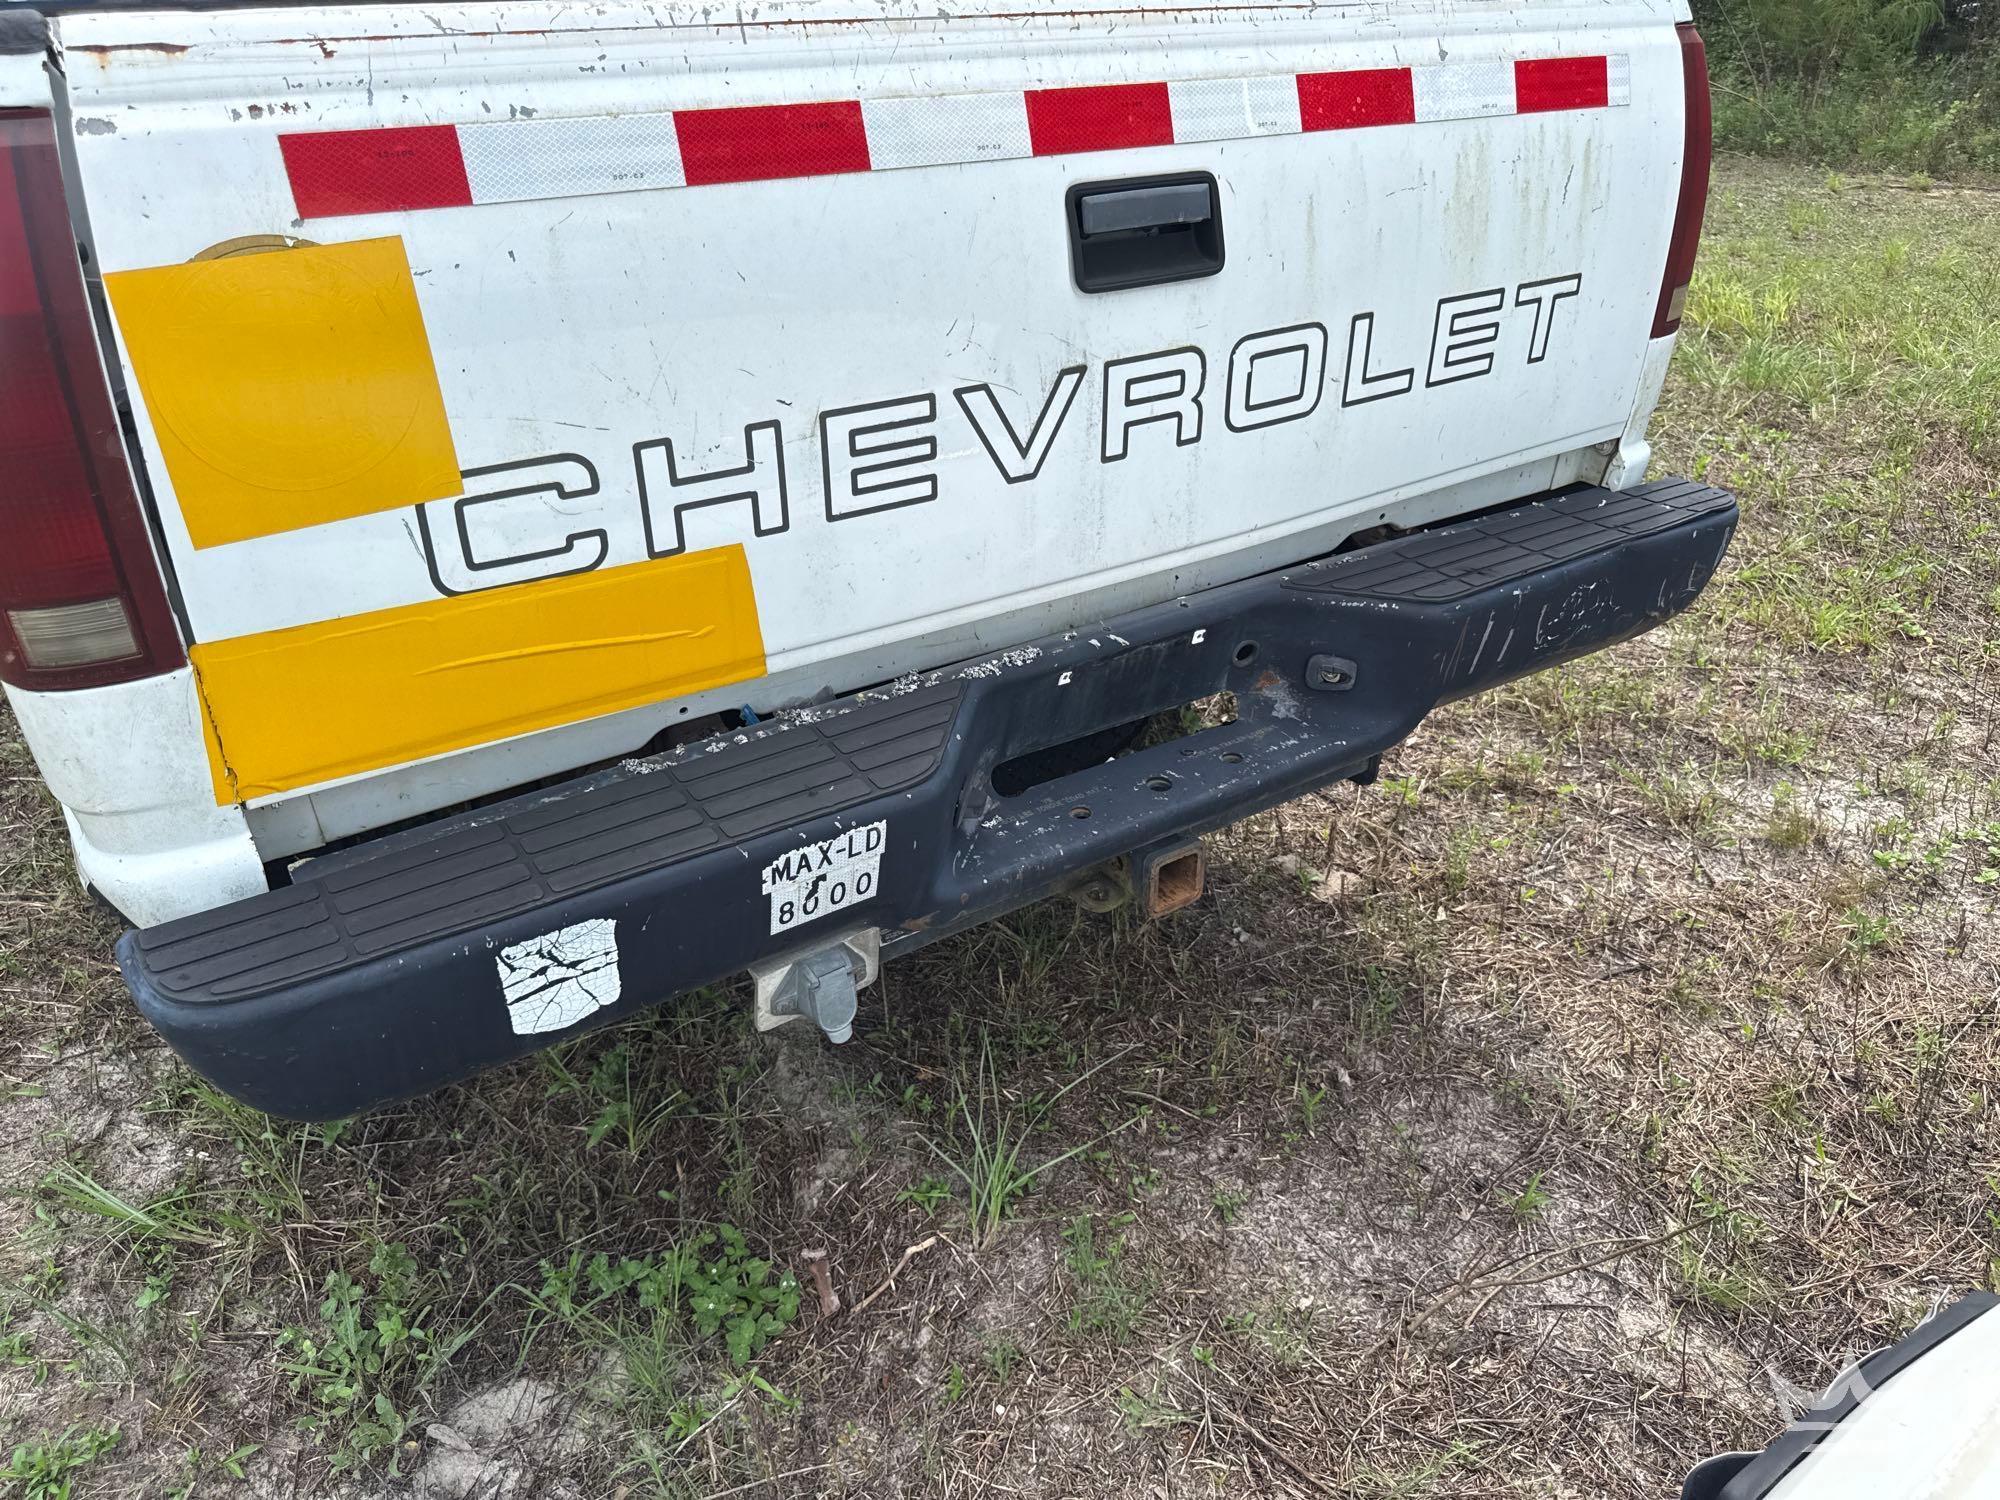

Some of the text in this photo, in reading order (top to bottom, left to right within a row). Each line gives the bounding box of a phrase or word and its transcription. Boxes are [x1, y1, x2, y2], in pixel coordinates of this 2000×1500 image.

[414, 272, 1582, 598] CHEVROLET
[771, 826, 882, 886] MAX-LD
[778, 872, 872, 925] 8000
